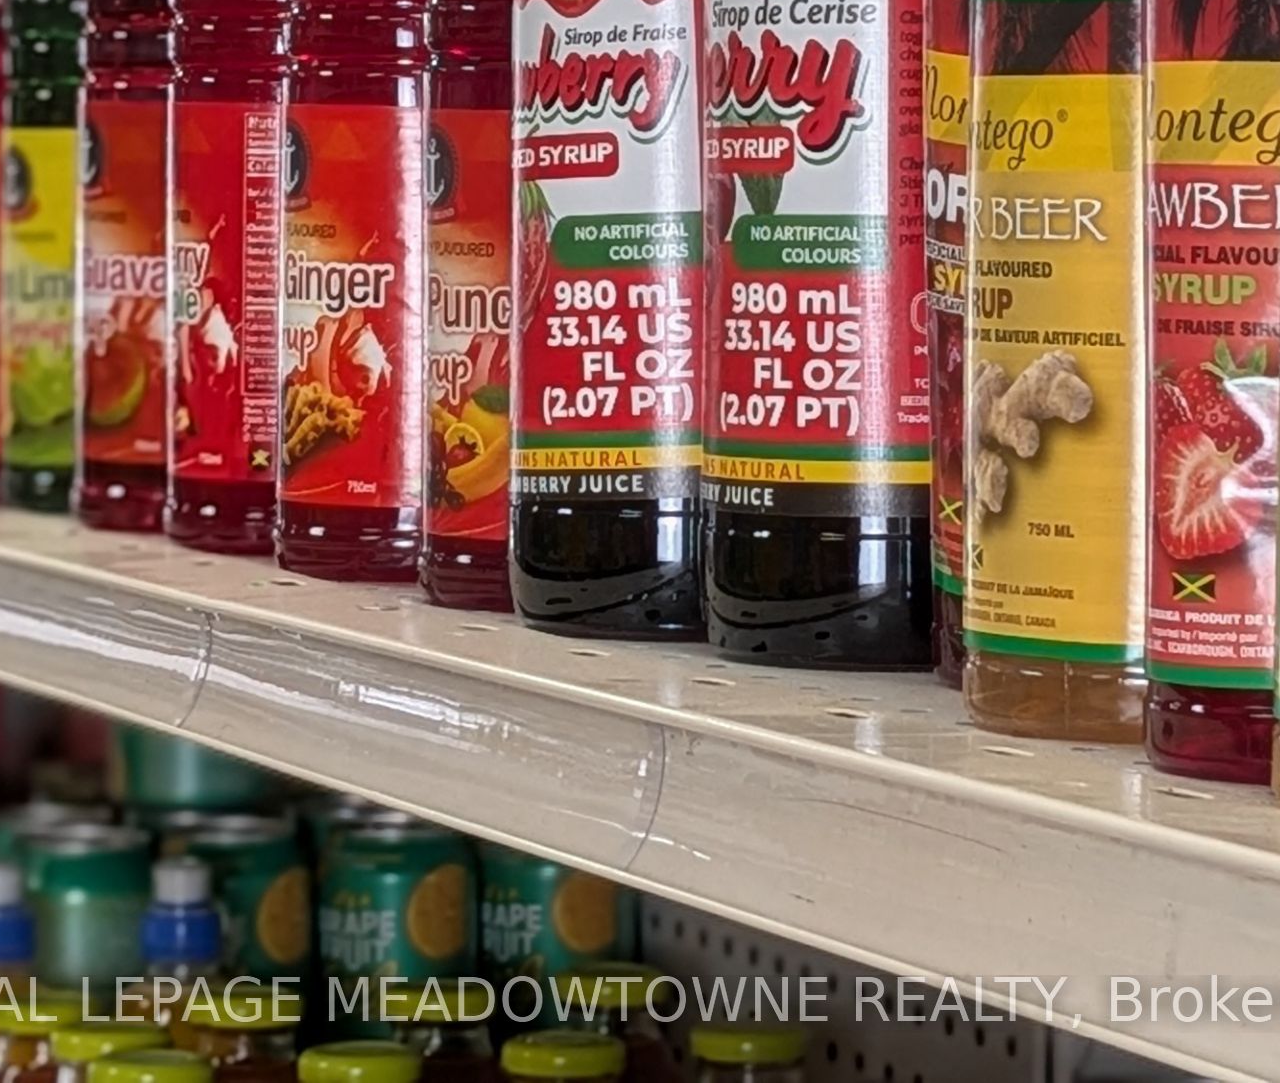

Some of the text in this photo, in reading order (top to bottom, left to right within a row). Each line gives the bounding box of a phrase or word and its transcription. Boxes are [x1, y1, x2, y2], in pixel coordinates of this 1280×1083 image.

[713, 0, 750, 31] Sirop
[564, 24, 687, 47] Sirop de Fraise
[539, 141, 614, 166] SYRUP
[722, 136, 790, 159] SYRUP
[990, 197, 1108, 241] BEER
[575, 223, 688, 241] NO ARTIFICIAL
[751, 225, 861, 243] NO ARTIFICIAL
[609, 244, 689, 261] COLOURS
[781, 247, 862, 264] COLOURS
[284, 253, 391, 313] Ginger
[553, 277, 692, 310] 980 mL
[731, 283, 862, 315] 980 mL
[546, 313, 693, 347] 33.14 US
[724, 319, 862, 353] 33.14 US
[994, 329, 1039, 344] SAVEUR
[1042, 331, 1126, 347] ARTIFICIEL
[1175, 319, 1235, 336] FRAISE
[582, 349, 694, 381] FL OZ
[753, 358, 862, 390] FL OZ
[542, 383, 694, 425] (2.07 PT)
[719, 391, 861, 436] (2.07 PT)
[545, 450, 643, 468] NATURAL
[721, 461, 805, 481] NATURAL
[578, 474, 645, 494] JUICE
[723, 488, 774, 506] JUICE
[1026, 522, 1075, 538] 750 ML
[1184, 611, 1242, 626] PRODUIT
[1244, 614, 1264, 626] DE
